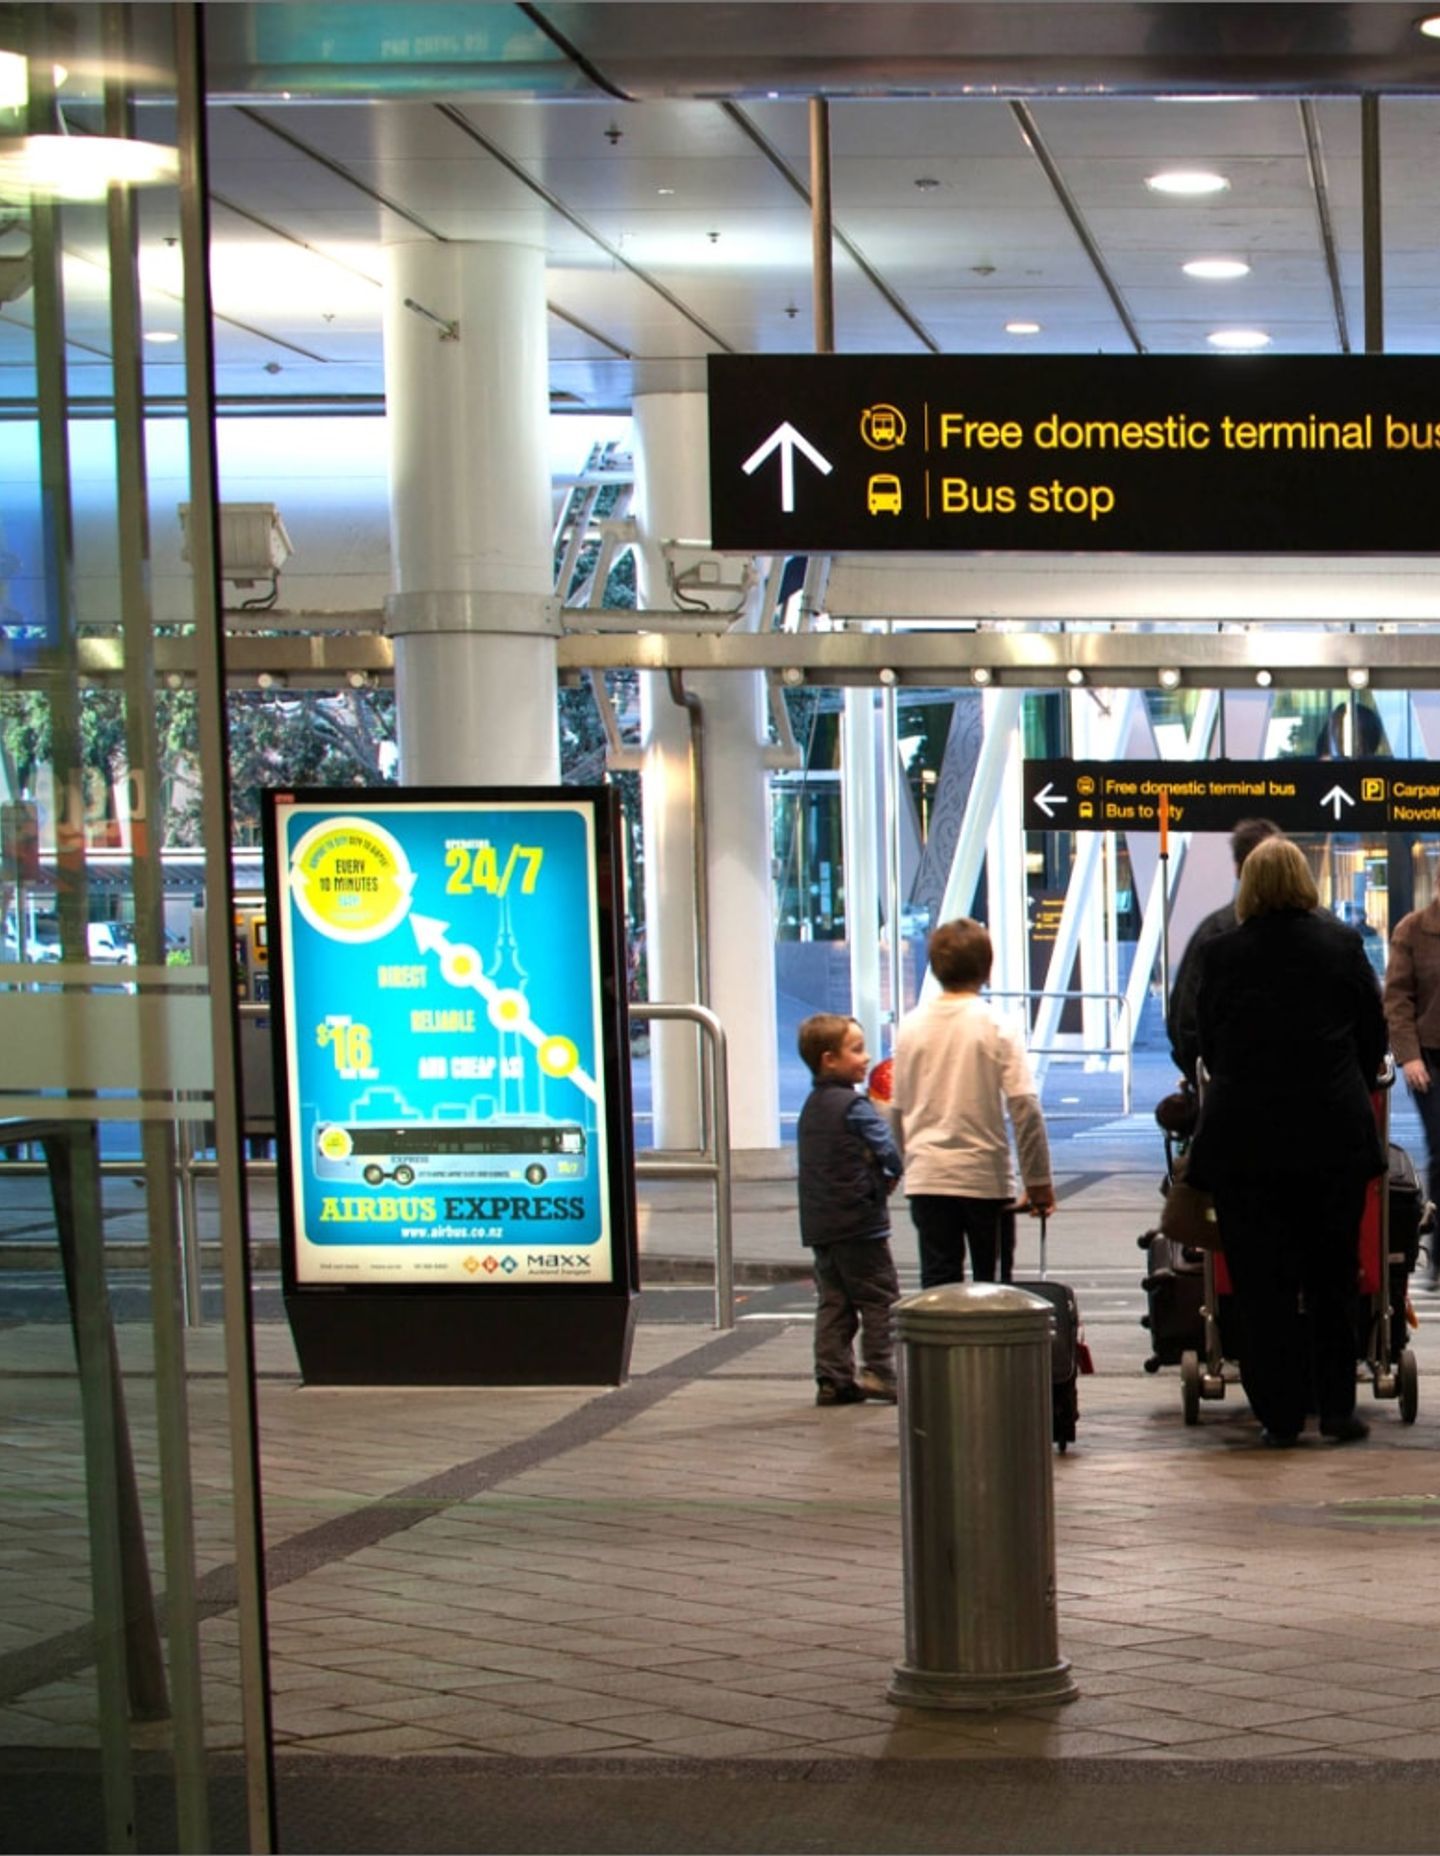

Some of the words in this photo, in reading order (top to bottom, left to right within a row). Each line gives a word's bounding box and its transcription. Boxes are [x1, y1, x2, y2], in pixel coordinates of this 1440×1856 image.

[940, 413, 1023, 450] Free
[1034, 413, 1210, 450] domestic
[1220, 414, 1372, 450] terminal
[941, 477, 1017, 513] Bus
[1028, 479, 1115, 521] stop
[1105, 779, 1138, 796] Free
[1140, 779, 1206, 797] domestic
[1208, 780, 1266, 797] terminal
[1268, 780, 1296, 797] bus
[1105, 803, 1136, 819] Bus
[1137, 804, 1155, 819] to
[1157, 804, 1184, 822] ty
[336, 859, 366, 874] EVERY
[445, 843, 544, 898] 24/7
[319, 877, 331, 892] 10
[334, 876, 379, 892] MINUTES
[378, 965, 426, 988] DIRECT
[411, 1010, 475, 1032] RELIABLE
[319, 1196, 437, 1222] AIRBUS
[443, 1196, 586, 1221] EXPRESS
[400, 1225, 504, 1239] www.airbus.co.nz
